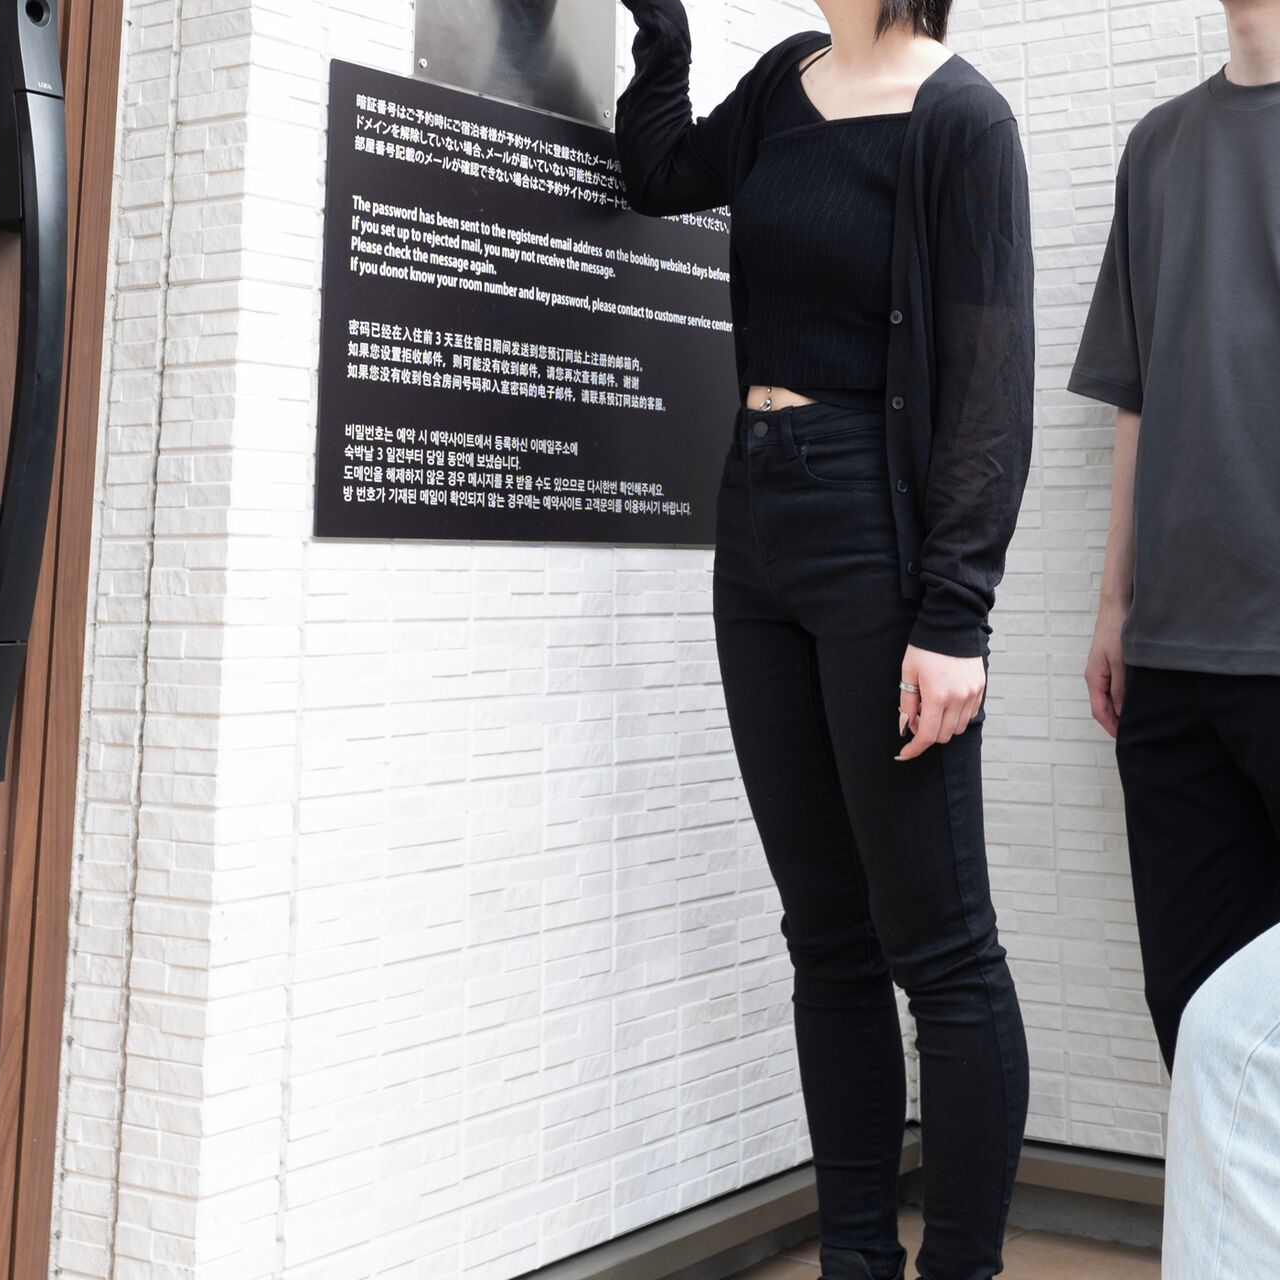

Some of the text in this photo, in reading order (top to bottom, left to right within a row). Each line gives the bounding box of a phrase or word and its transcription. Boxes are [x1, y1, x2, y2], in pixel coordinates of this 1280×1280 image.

[350, 235, 497, 276] Please check the message again.
[351, 214, 616, 279] If you set up to rejected mail, you may not receive the message.
[352, 194, 371, 213] The
[372, 202, 418, 221] password
[418, 207, 435, 225] has
[436, 210, 459, 230] been
[460, 219, 480, 234] sent
[480, 221, 490, 235] to
[491, 222, 506, 239] the
[506, 228, 549, 247] registered
[549, 237, 572, 251] email
[572, 239, 603, 257] address
[604, 248, 615, 259] on
[616, 248, 629, 262] the
[629, 250, 659, 271] booking
[691, 263, 708, 280] days
[350, 255, 359, 271] If
[358, 260, 378, 276] you
[409, 265, 435, 284] know
[436, 273, 458, 288] your
[458, 277, 482, 292] room
[483, 281, 518, 297] number
[518, 286, 535, 300] and
[535, 286, 550, 306] key
[551, 293, 591, 311] password,
[591, 297, 616, 313] please
[616, 304, 644, 318] contact
[644, 307, 653, 319] to
[654, 310, 687, 325] customer
[687, 315, 711, 329] service
[344, 423, 578, 456] 비밀번호는 예약 시 예약사이트에서 등록하신 이메일주소에
[344, 443, 521, 470] 숙박날 3 일전부터 당일 동안에 보냈습니다.
[343, 465, 664, 496] 도메인을 해제하지 않은 경우 메시지를 못 받을 수도 있으므로 다시한번 확인해주세요.
[342, 485, 691, 515] 방 번호가 기재된 메일이 확인되지 않는 경우에는 예약사이트 고객문의를 이용하시기 바랍니다.
